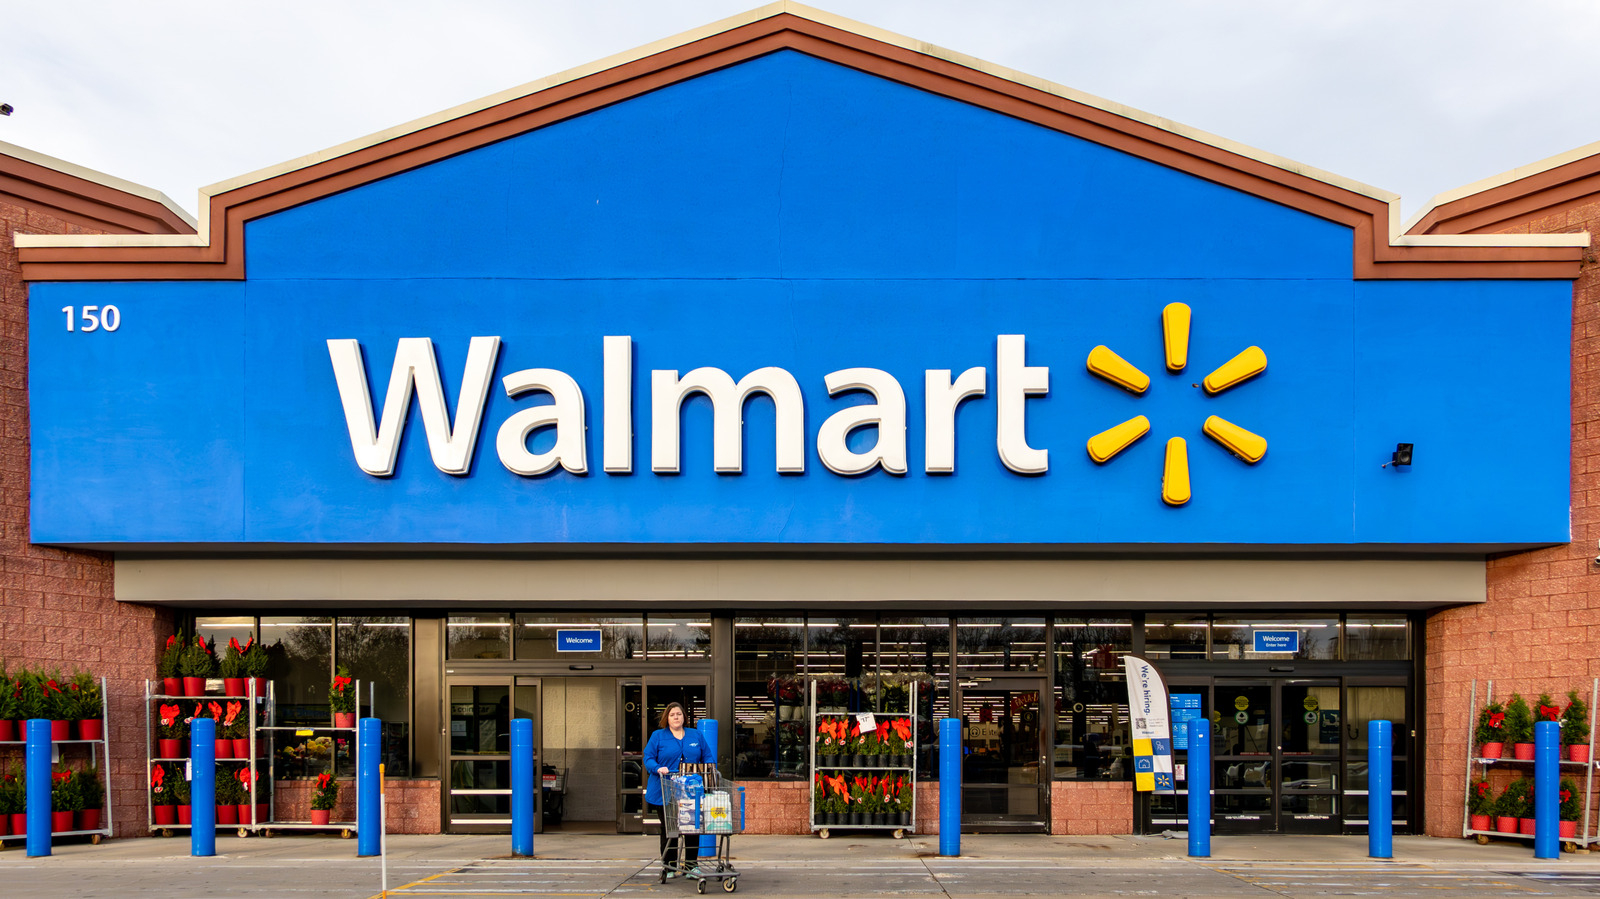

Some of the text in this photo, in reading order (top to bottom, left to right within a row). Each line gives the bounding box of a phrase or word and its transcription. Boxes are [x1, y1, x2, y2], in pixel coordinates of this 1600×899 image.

[61, 304, 121, 332] 150
[326, 334, 1049, 477] Walmart
[1141, 664, 1152, 716] We're hiring.
